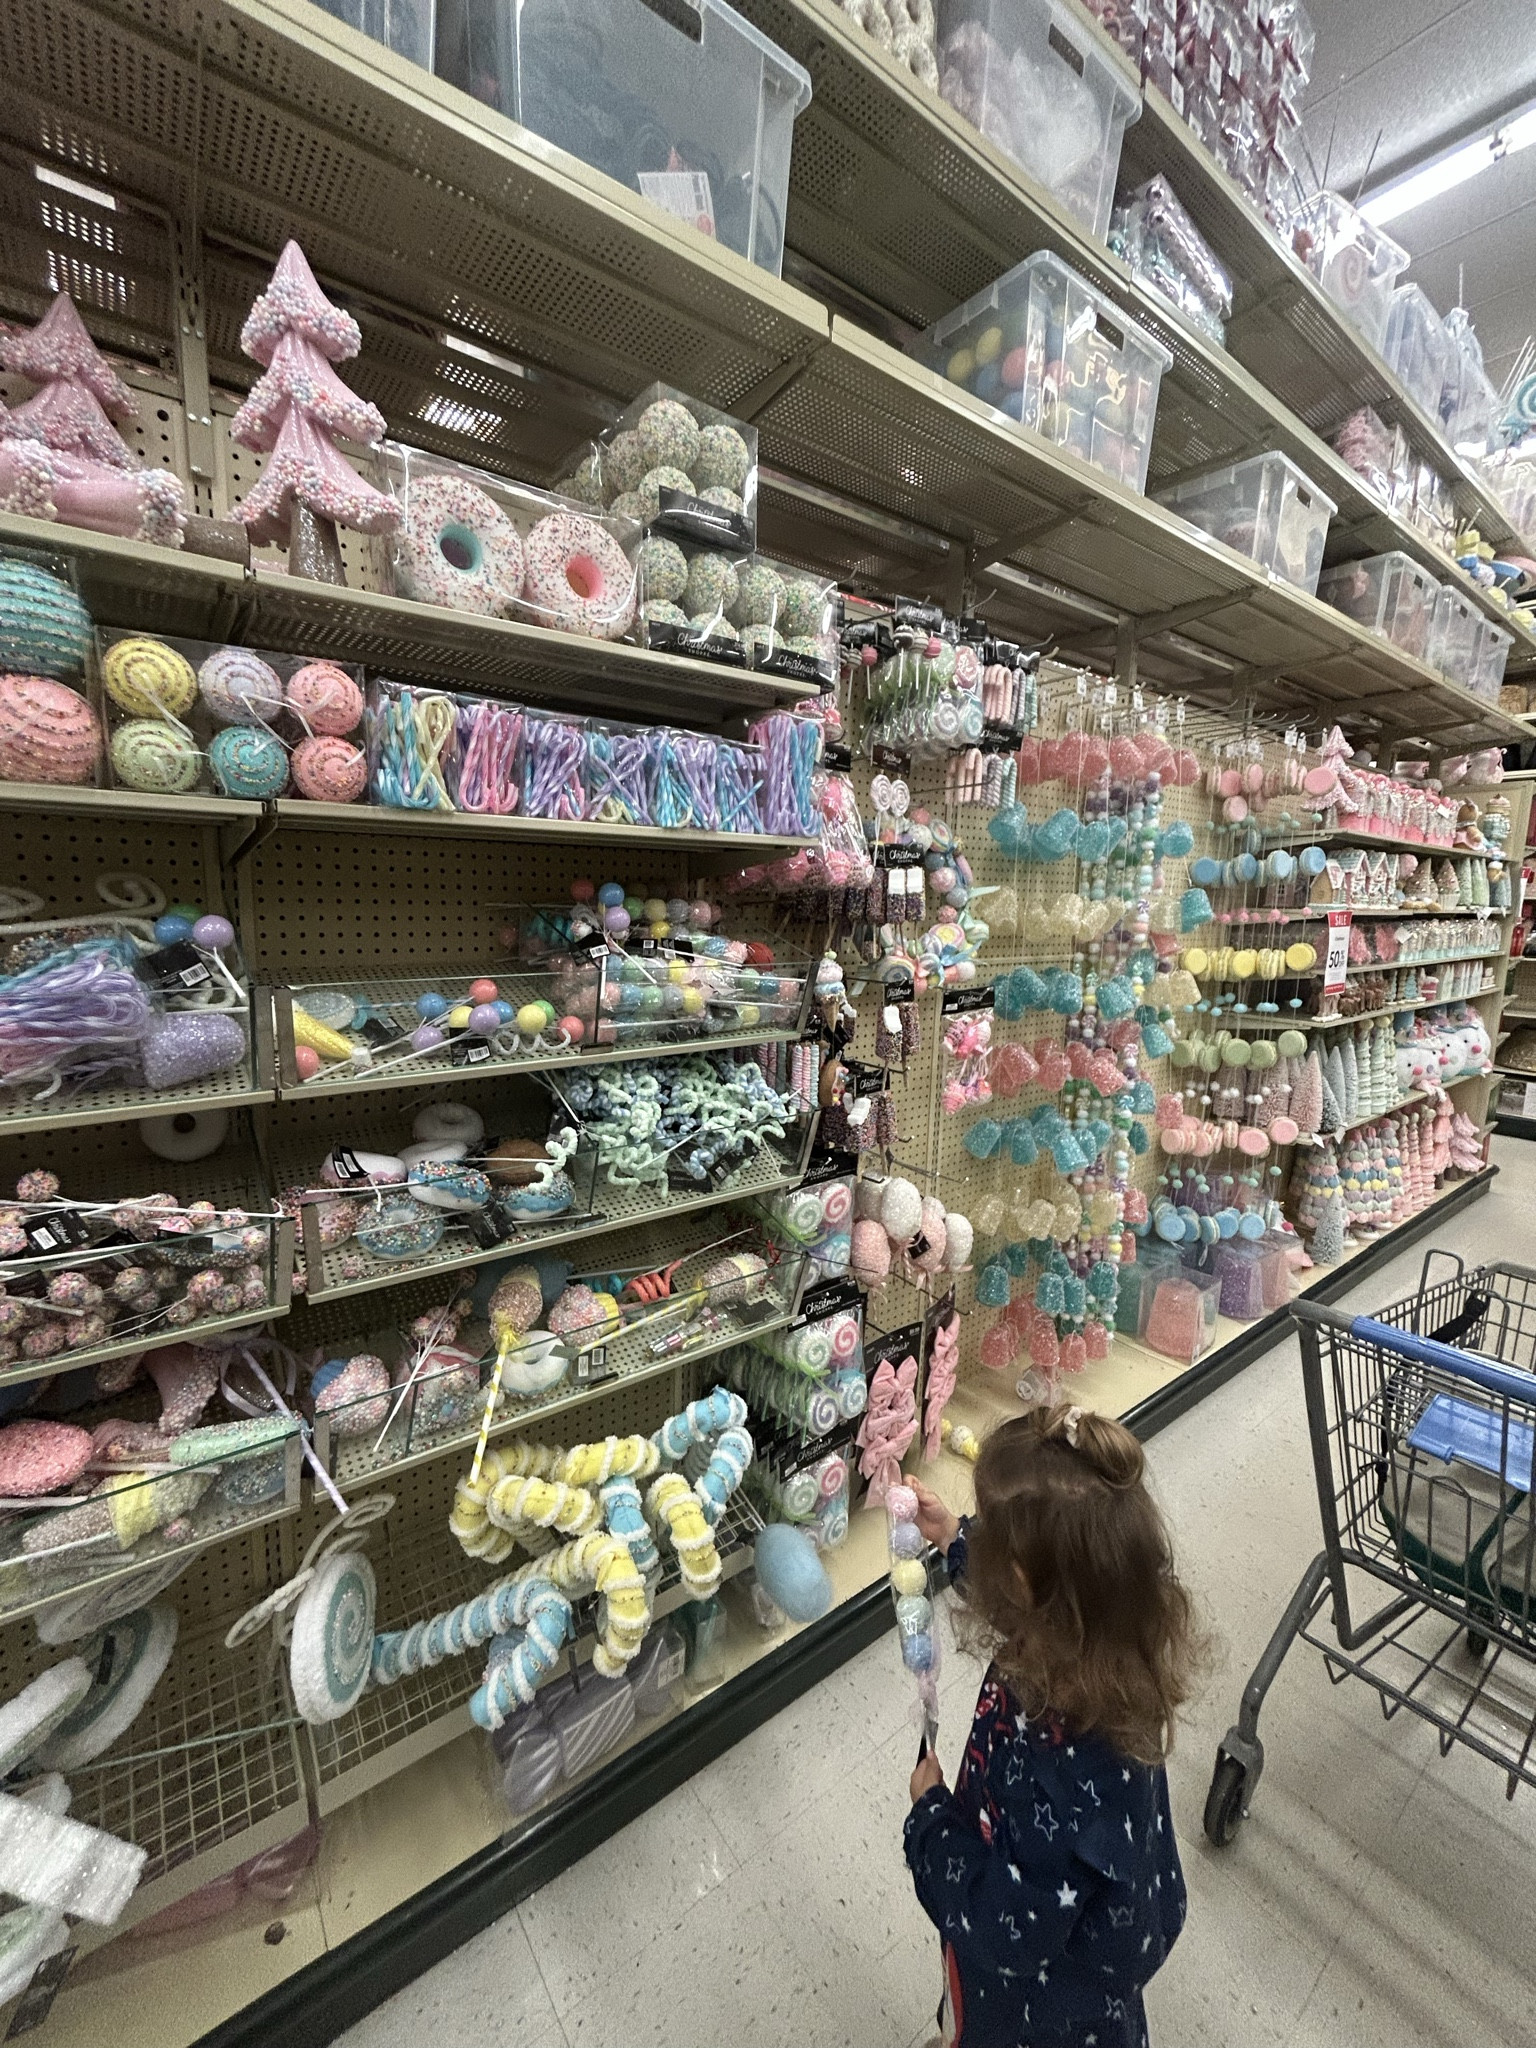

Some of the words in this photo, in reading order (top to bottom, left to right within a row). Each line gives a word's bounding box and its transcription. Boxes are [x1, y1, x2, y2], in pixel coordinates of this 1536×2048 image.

[778, 655, 816, 676] Christmas
[889, 850, 920, 860] Christmas
[1335, 914, 1347, 926] SALE
[1328, 950, 1340, 969] 50
[805, 1163, 839, 1178] hristmas
[805, 1295, 842, 1315] Christmas
[874, 1341, 910, 1364] Christmas
[797, 1437, 833, 1462] Christmas
